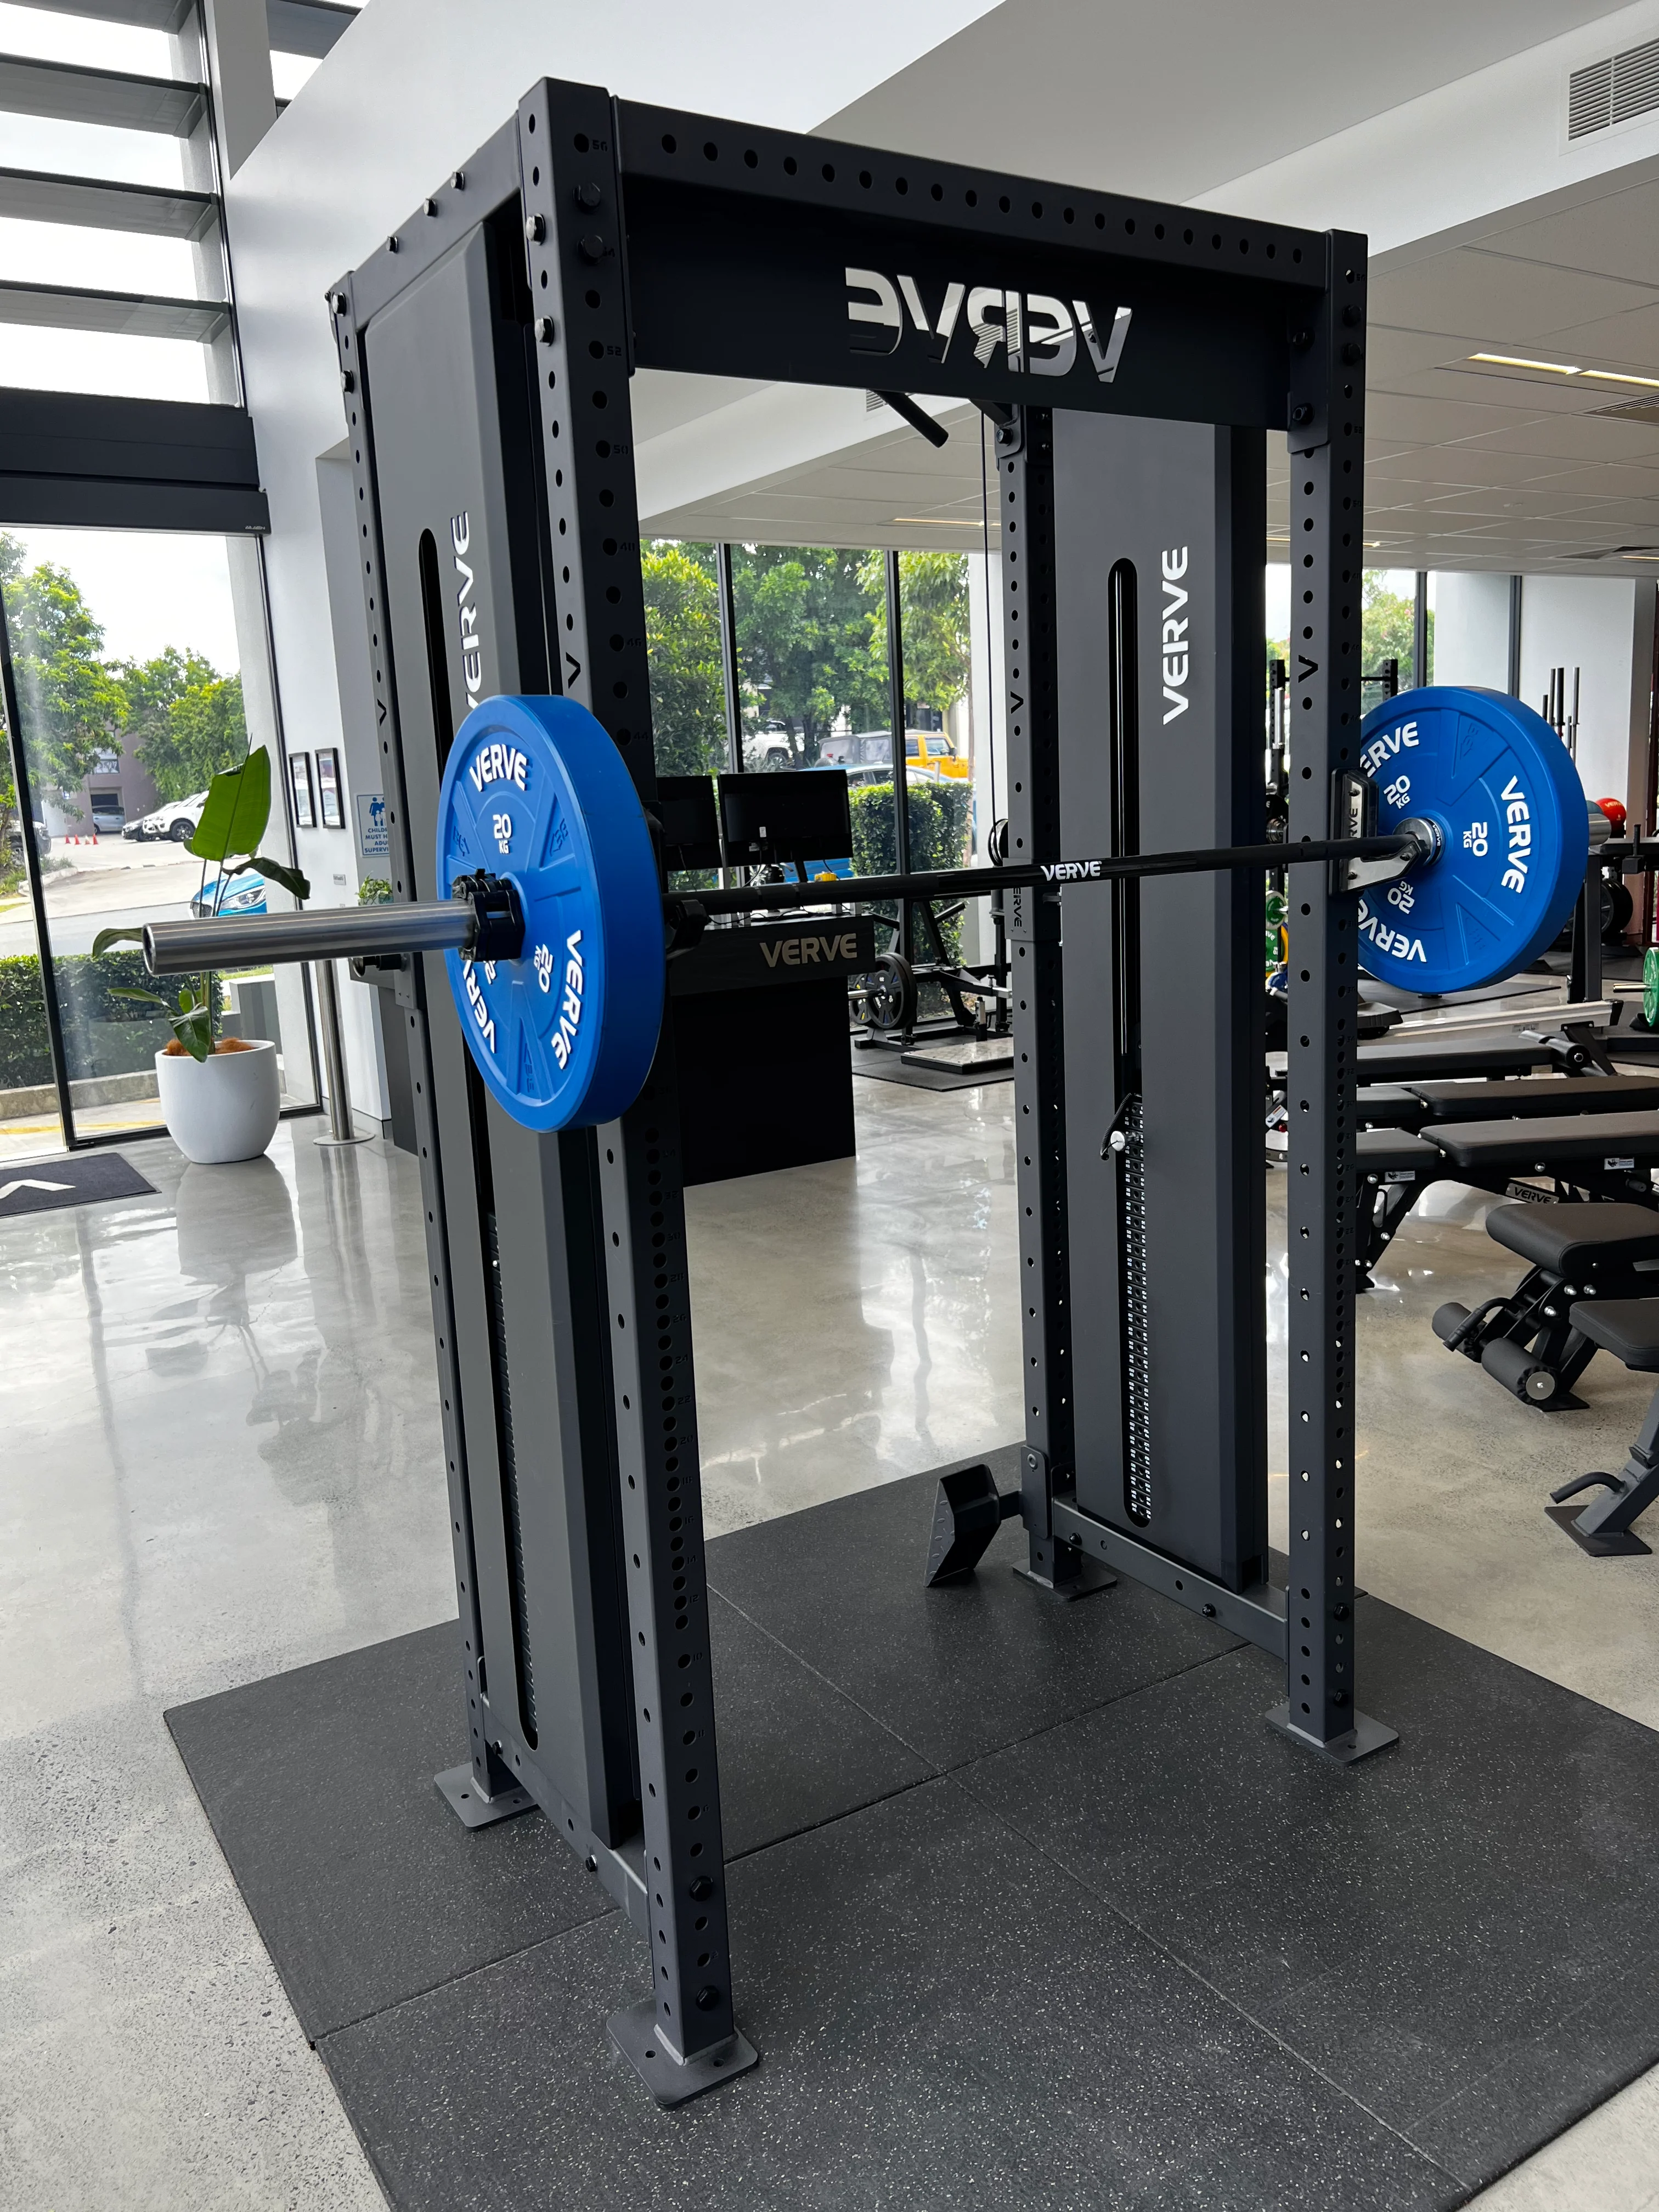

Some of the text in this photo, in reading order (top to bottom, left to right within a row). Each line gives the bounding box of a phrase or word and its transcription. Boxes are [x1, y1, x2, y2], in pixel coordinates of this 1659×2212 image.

[1161, 546, 1189, 725] VERVE
[1360, 721, 1419, 777] ERVE
[469, 743, 527, 792] VERVE
[1383, 775, 1410, 805] 20
[1396, 793, 1410, 809] KG
[493, 814, 512, 839] 20
[1348, 808, 1358, 838] RVE
[1432, 824, 1441, 847] VERVE
[1501, 775, 1531, 893] VERVE
[499, 840, 509, 854] KG
[1463, 831, 1472, 848] KG
[1472, 822, 1488, 856] 20
[1387, 888, 1415, 914] 20
[1399, 881, 1413, 895] KG
[1013, 887, 1022, 927] ERVE
[534, 945, 541, 970] KG
[759, 933, 857, 968] VERVE
[539, 944, 553, 993] 20
[463, 960, 495, 1053] VER
[551, 930, 583, 1070] VERVE
[1515, 1187, 1552, 1204] VERVE
